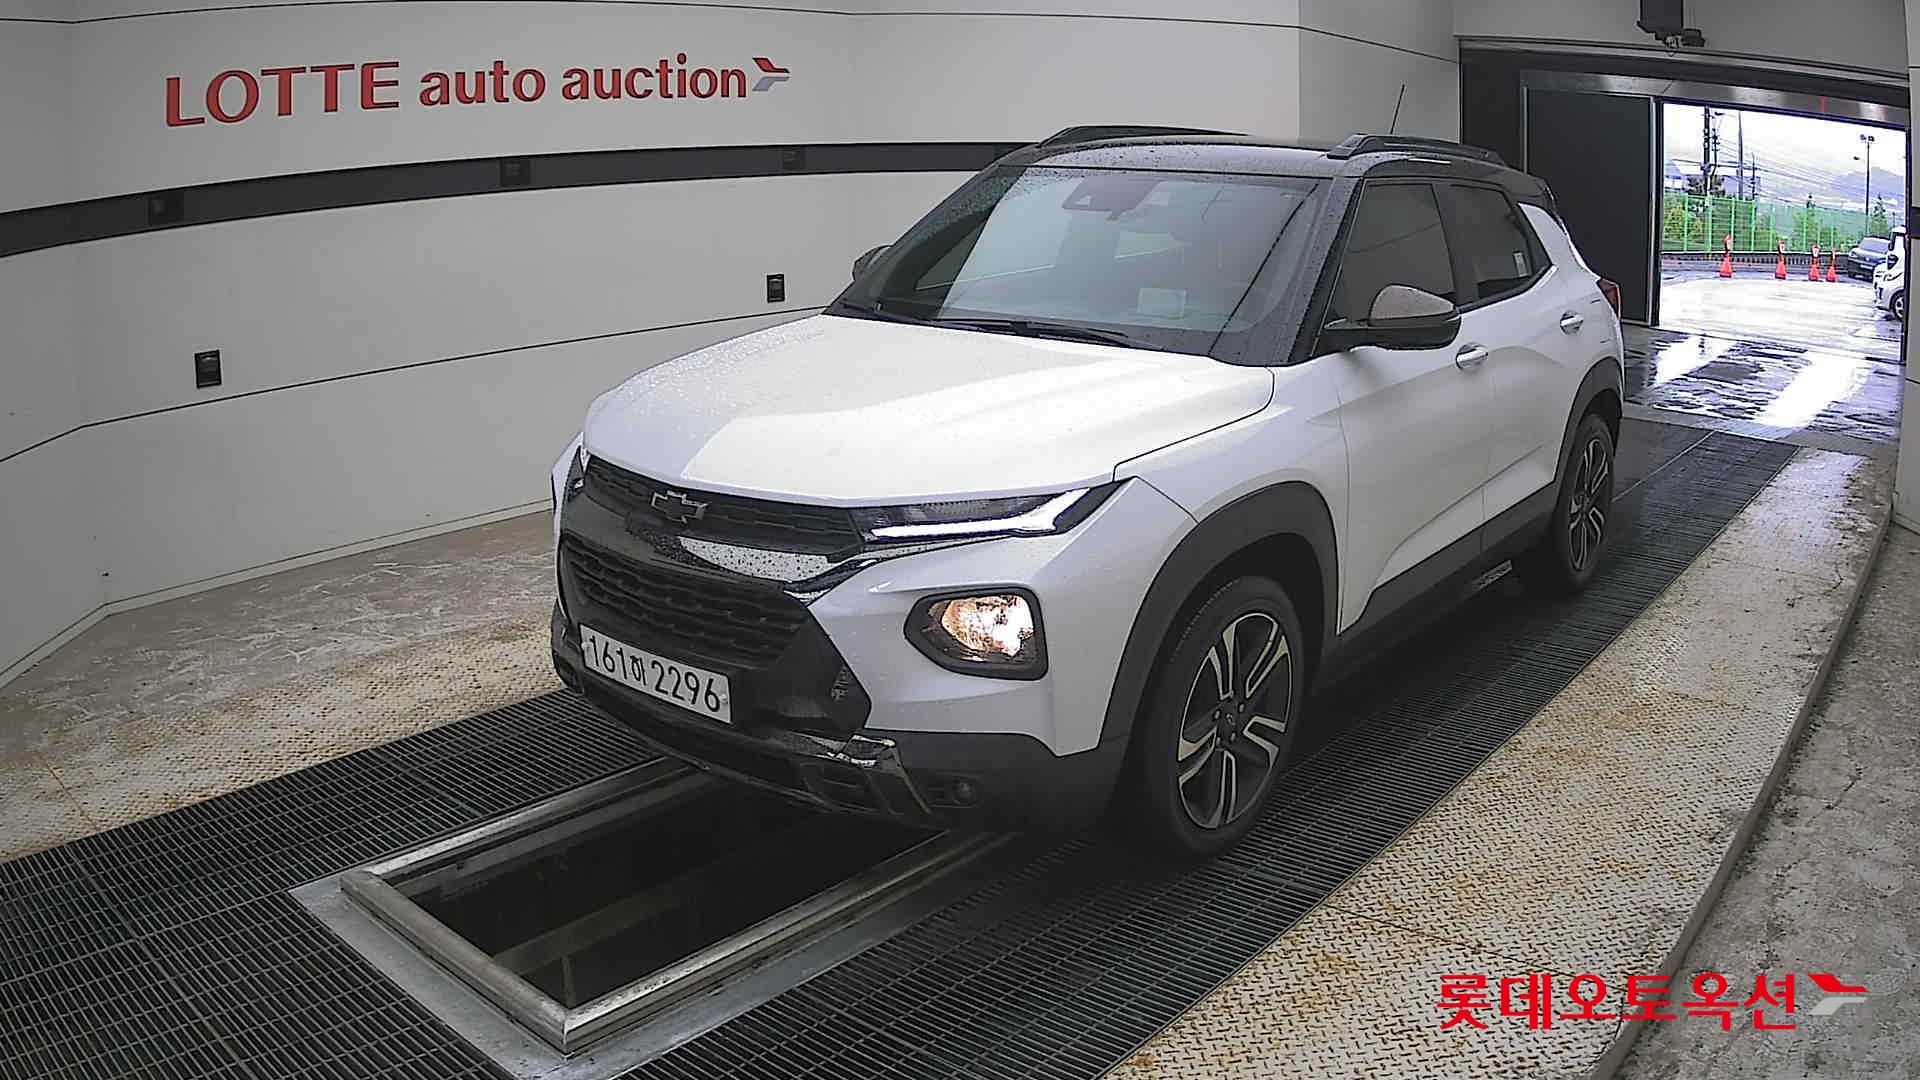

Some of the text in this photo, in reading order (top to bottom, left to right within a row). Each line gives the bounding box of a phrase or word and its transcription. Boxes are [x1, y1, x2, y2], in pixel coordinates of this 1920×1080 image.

[165, 53, 747, 127] LOTTE auto auction
